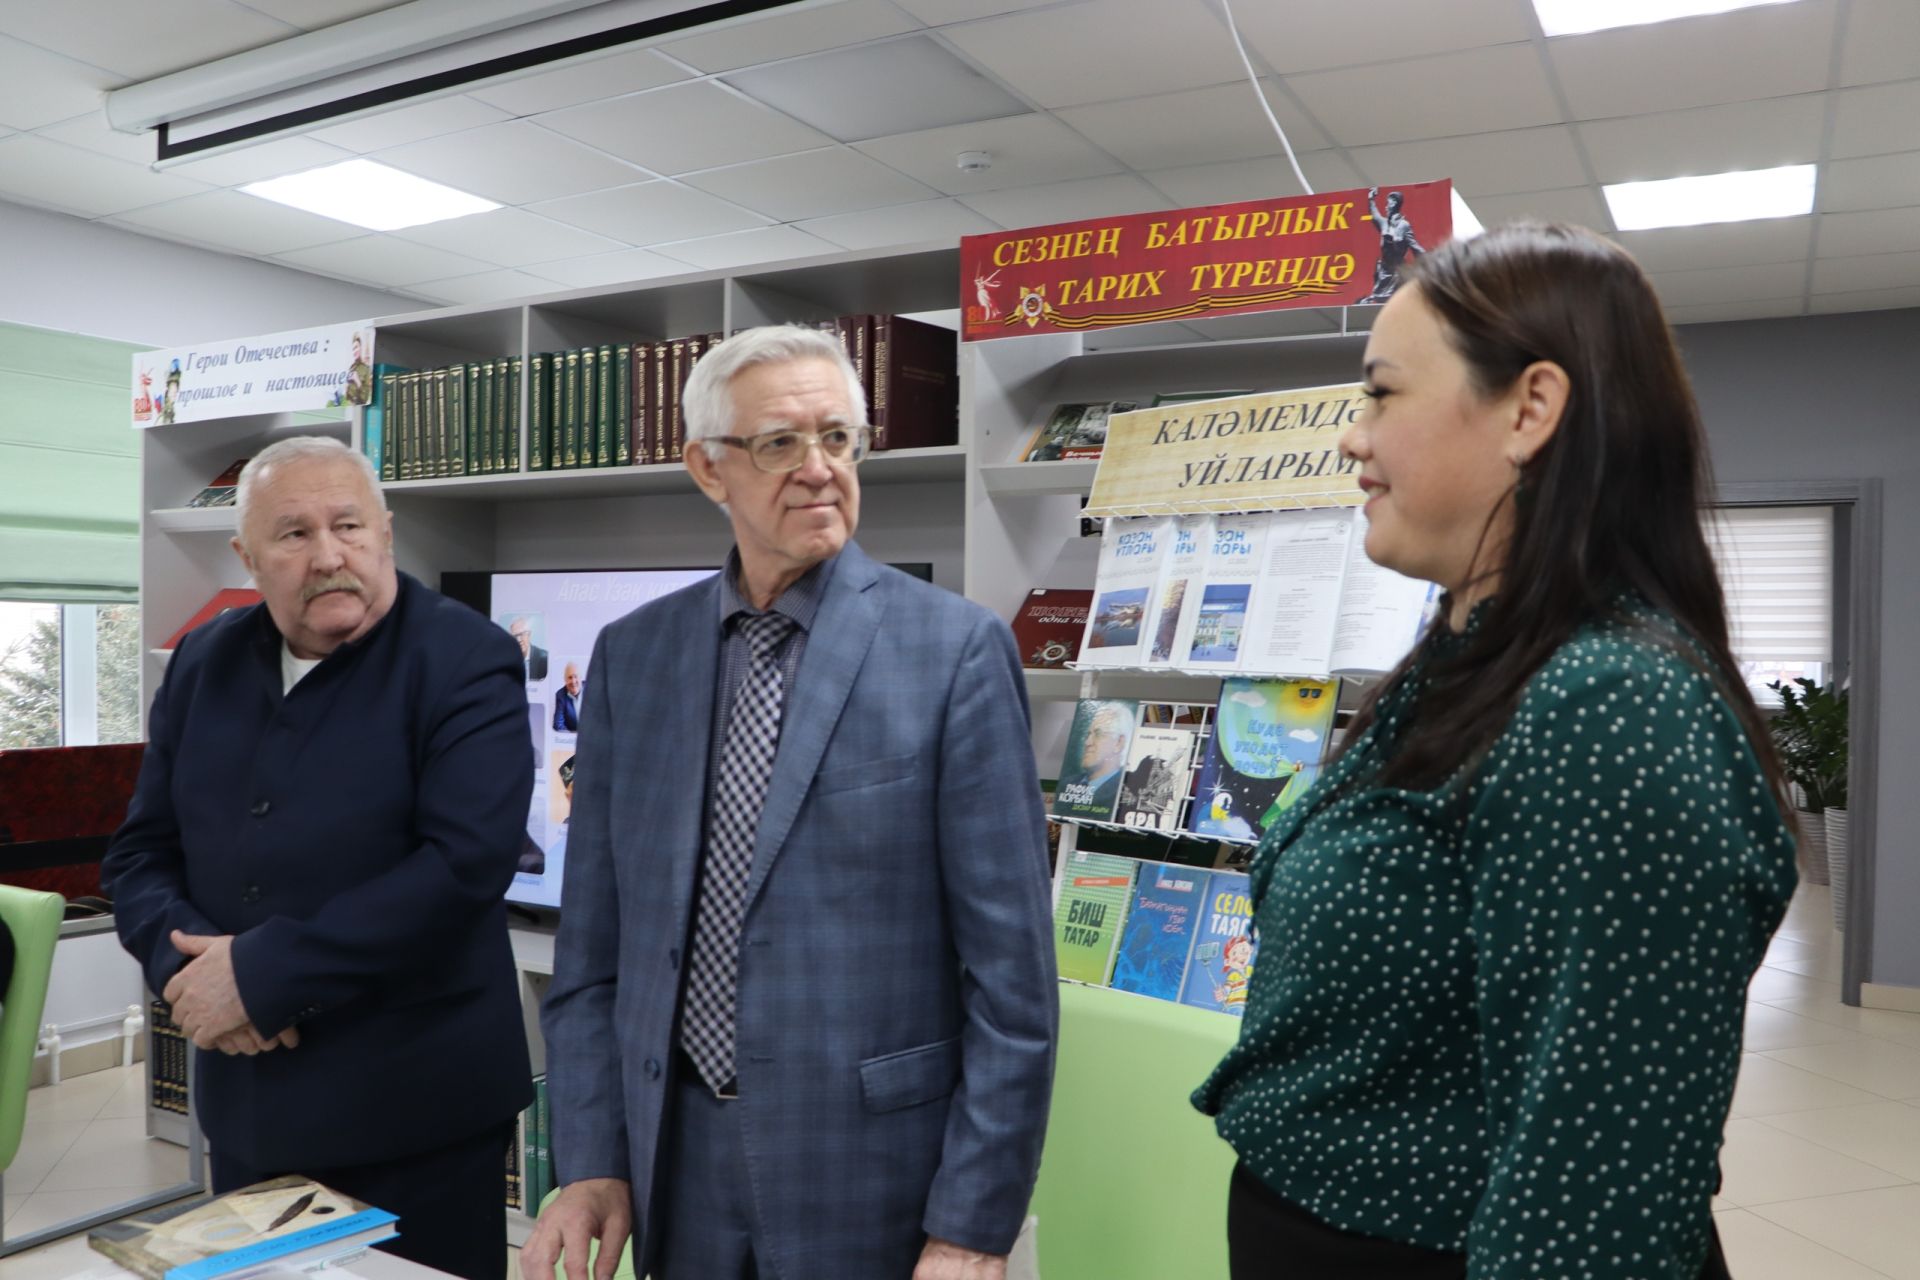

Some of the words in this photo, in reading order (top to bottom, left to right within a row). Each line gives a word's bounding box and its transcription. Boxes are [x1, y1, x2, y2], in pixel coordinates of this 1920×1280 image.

[994, 227, 1123, 267] СЕЗНЕҢ
[1146, 201, 1356, 249] БАТЫРЛЫК
[1057, 270, 1165, 307] ТАРИХ
[1190, 253, 1356, 293] ТҮРЕНДӘ
[185, 352, 229, 373] Герои
[235, 339, 318, 364] Отечества
[177, 382, 236, 407] прошлое
[243, 382, 253, 395] и
[1068, 899, 1107, 928] БИШ
[1063, 926, 1100, 948] ТАТАР
